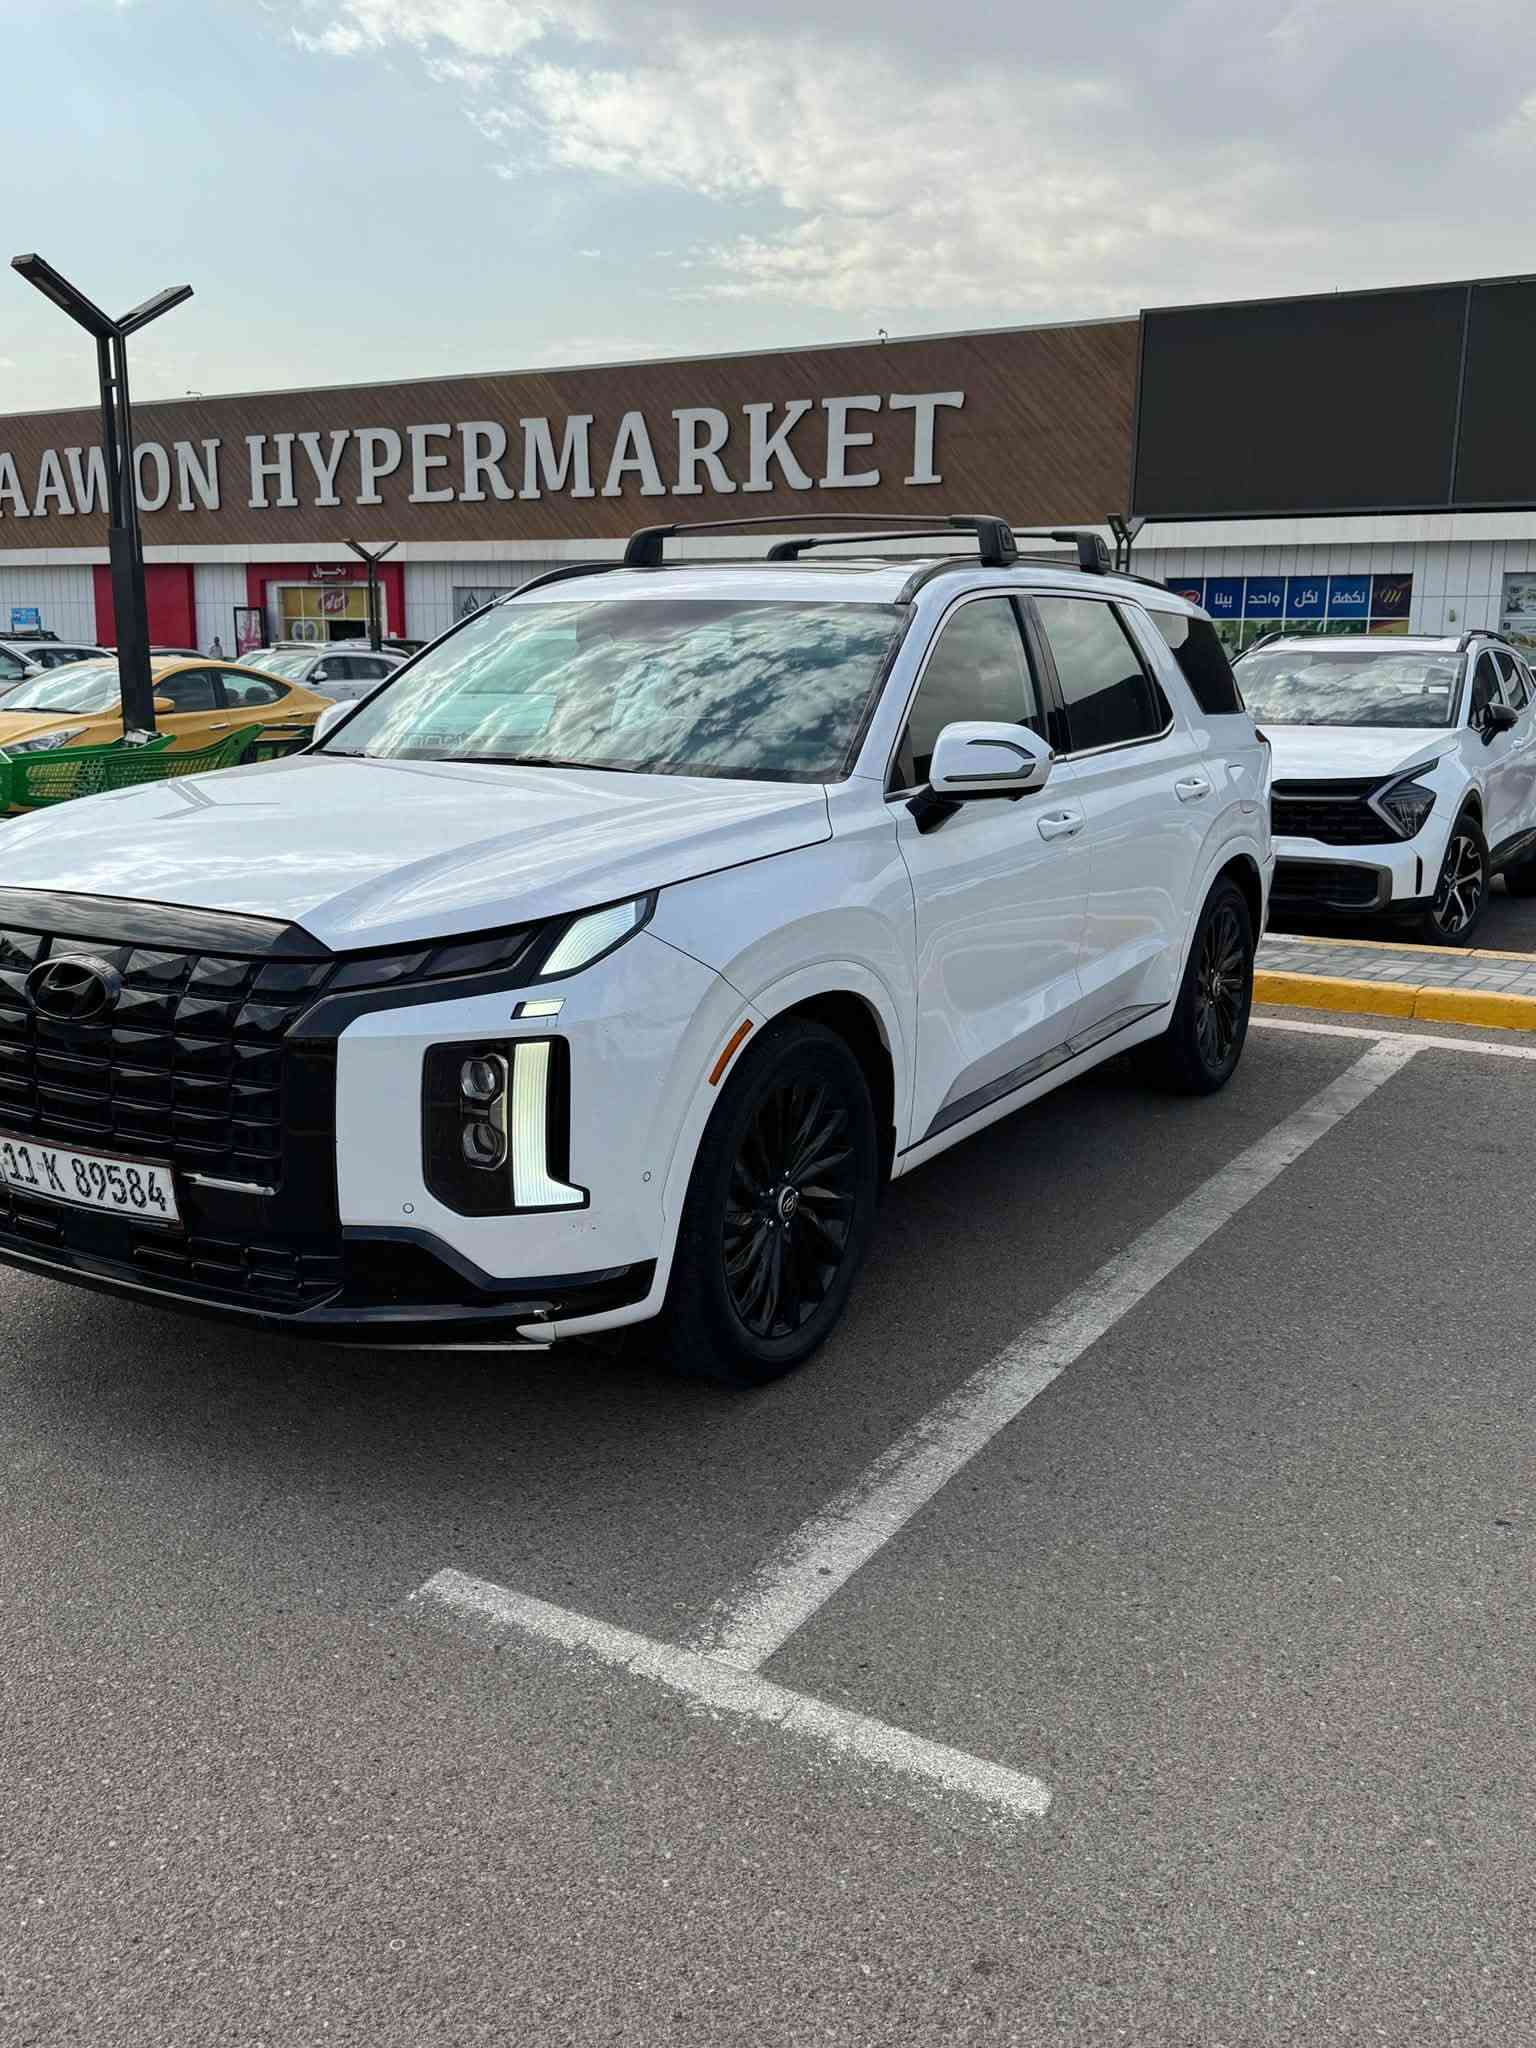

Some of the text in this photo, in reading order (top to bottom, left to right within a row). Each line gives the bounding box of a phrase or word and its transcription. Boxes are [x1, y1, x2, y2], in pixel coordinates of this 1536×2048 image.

[245, 391, 965, 509] HYPERMARKET
[1214, 591, 1233, 608] بينا
[1248, 591, 1280, 608] واحد
[1294, 589, 1319, 608] لكل
[42, 1151, 66, 1192] K
[71, 1158, 166, 1211] 89584
